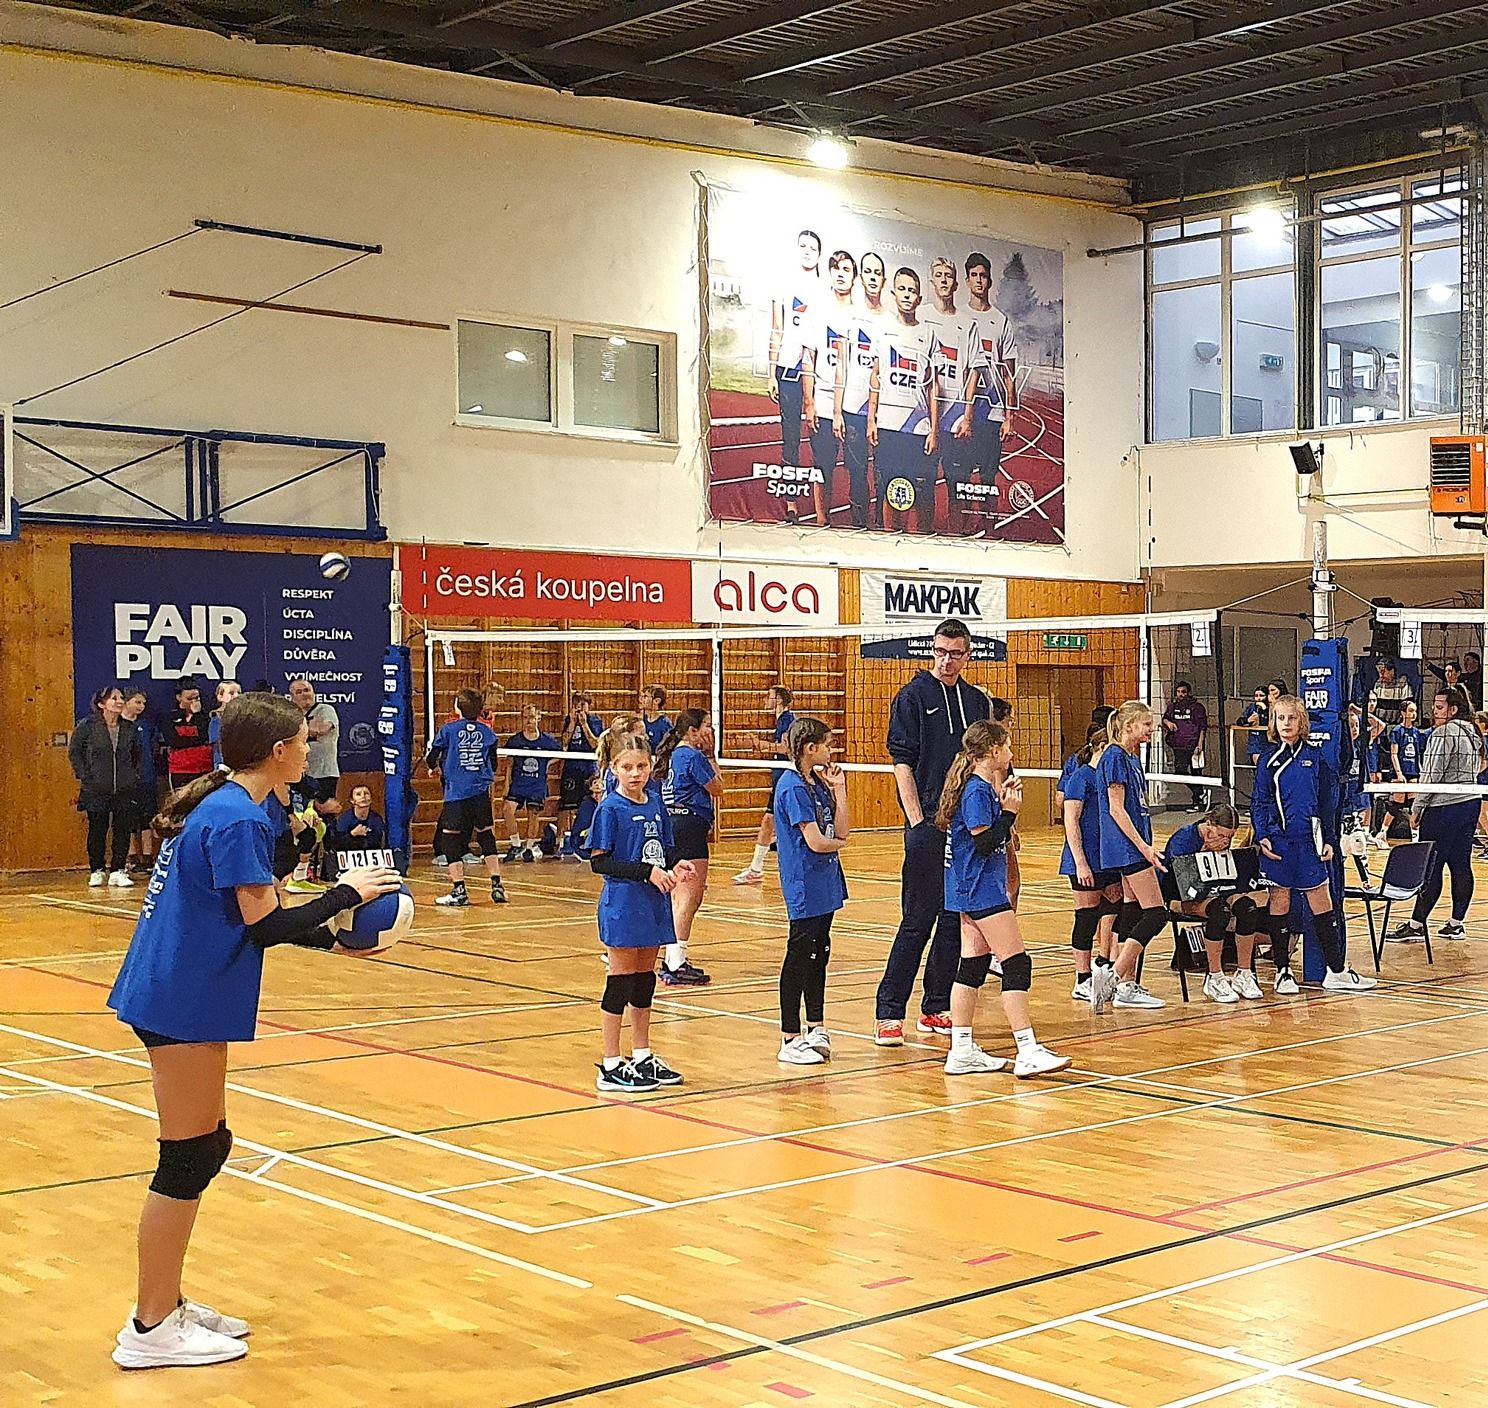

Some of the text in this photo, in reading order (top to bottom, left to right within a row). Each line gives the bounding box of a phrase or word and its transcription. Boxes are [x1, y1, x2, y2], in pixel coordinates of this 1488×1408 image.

[890, 372, 917, 389] CZE
[753, 463, 824, 483] FOSFA
[767, 480, 810, 498] Sport
[956, 482, 1000, 496] FOSFA
[282, 588, 334, 599] RESPEKT
[435, 567, 664, 607] česká koupelna
[713, 571, 819, 614] alca
[885, 583, 981, 615] MAKPAK
[282, 607, 315, 619] ÚCTA
[114, 603, 248, 644] FAIR
[283, 628, 353, 640] DISCIPLÍNA
[1196, 629, 1204, 642] 2.
[1407, 630, 1417, 644] 3.
[283, 647, 336, 660] DŮVĚRA
[115, 644, 248, 680] PLAY
[284, 671, 363, 682] VYJÍMEČNOST
[1301, 668, 1332, 677] FOSFA
[1306, 677, 1325, 685] Sport
[1305, 690, 1328, 701] FAIR
[1305, 700, 1327, 709] PLAY
[458, 730, 484, 748] 22
[352, 853, 364, 867] 12
[372, 852, 379, 866] 5
